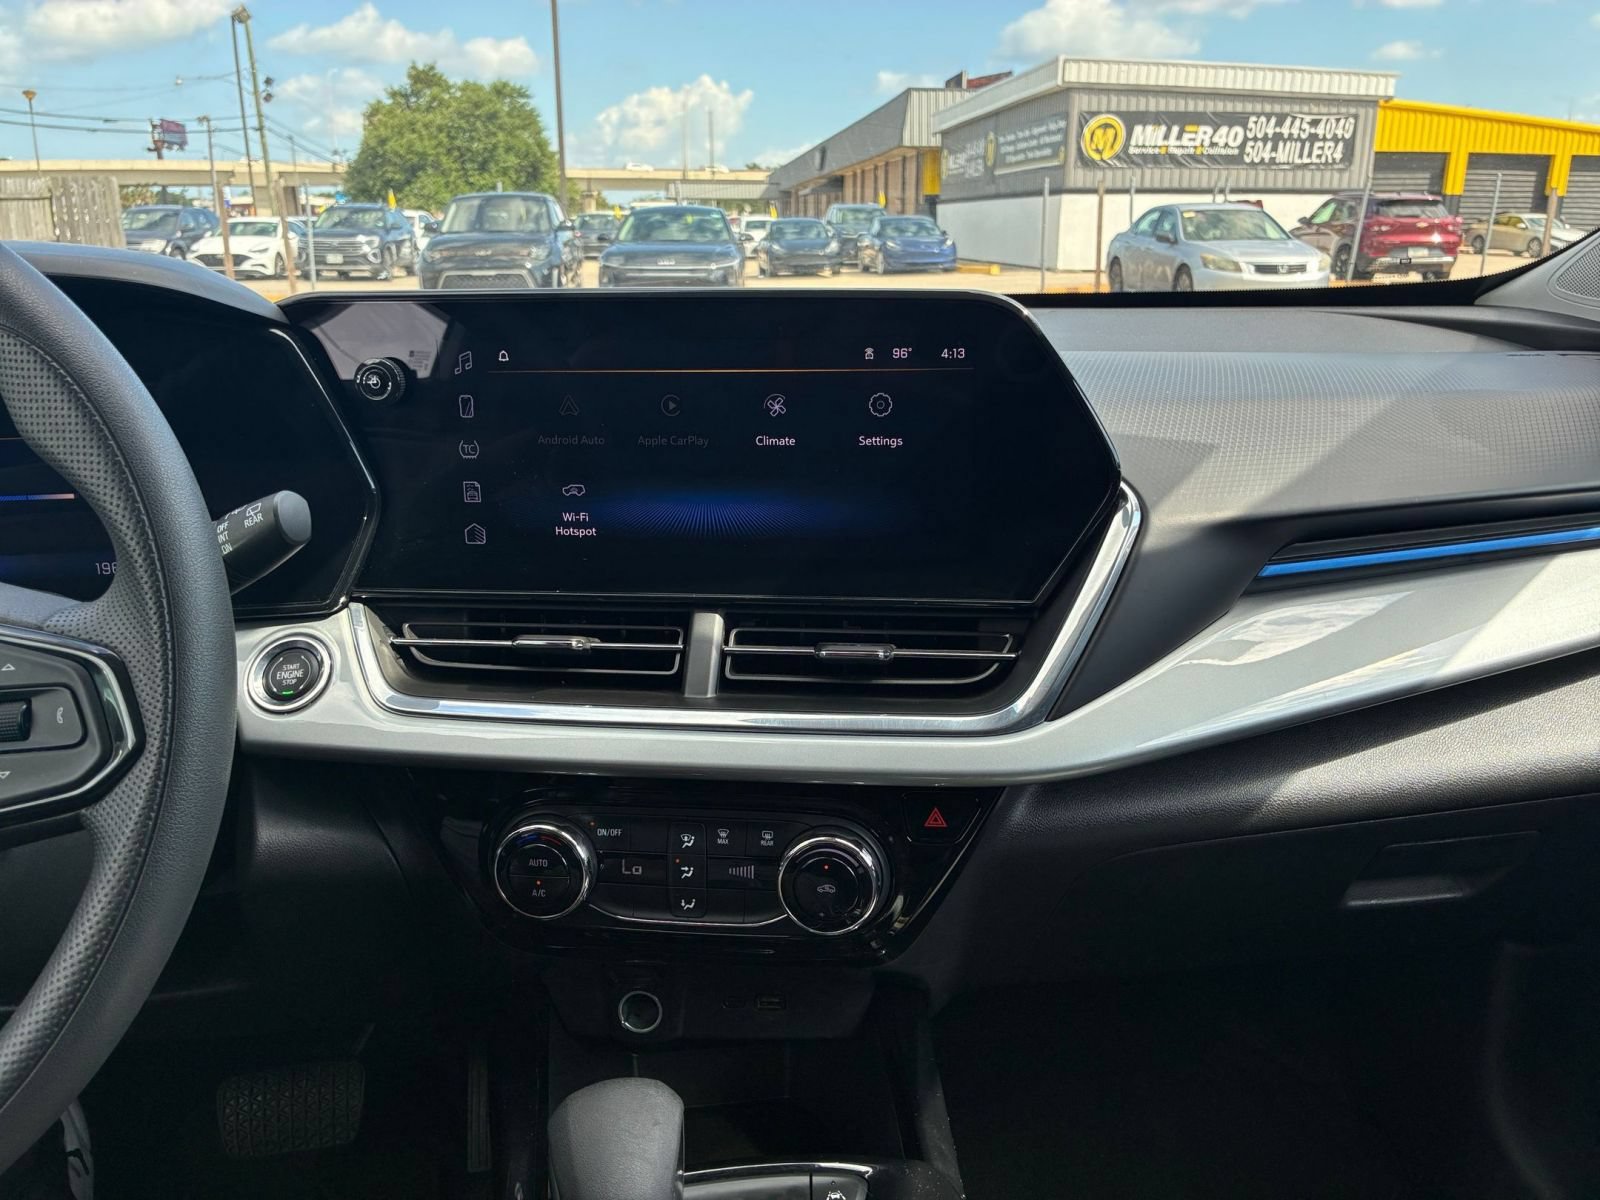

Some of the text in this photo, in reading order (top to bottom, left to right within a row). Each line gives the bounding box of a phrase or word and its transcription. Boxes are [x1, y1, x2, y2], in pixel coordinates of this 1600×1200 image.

[1246, 115, 1355, 139] 504-445-4040
[1243, 140, 1344, 163] 504-MILLER4
[941, 348, 965, 359] 4:13
[538, 434, 605, 445] Android Auto
[638, 435, 709, 448] Apple CarPlay
[755, 435, 796, 446] Climate
[858, 435, 903, 449] Settings
[244, 513, 264, 528] REAR
[562, 512, 589, 522] Wi-Fi
[217, 521, 229, 533] OFF
[555, 526, 597, 538] Hotspot
[221, 543, 233, 555] ON
[282, 663, 301, 671] START
[276, 669, 304, 680] ENGINE
[597, 828, 622, 837] ON/OFF
[528, 859, 548, 868] AUTO
[532, 889, 546, 898] A/C
